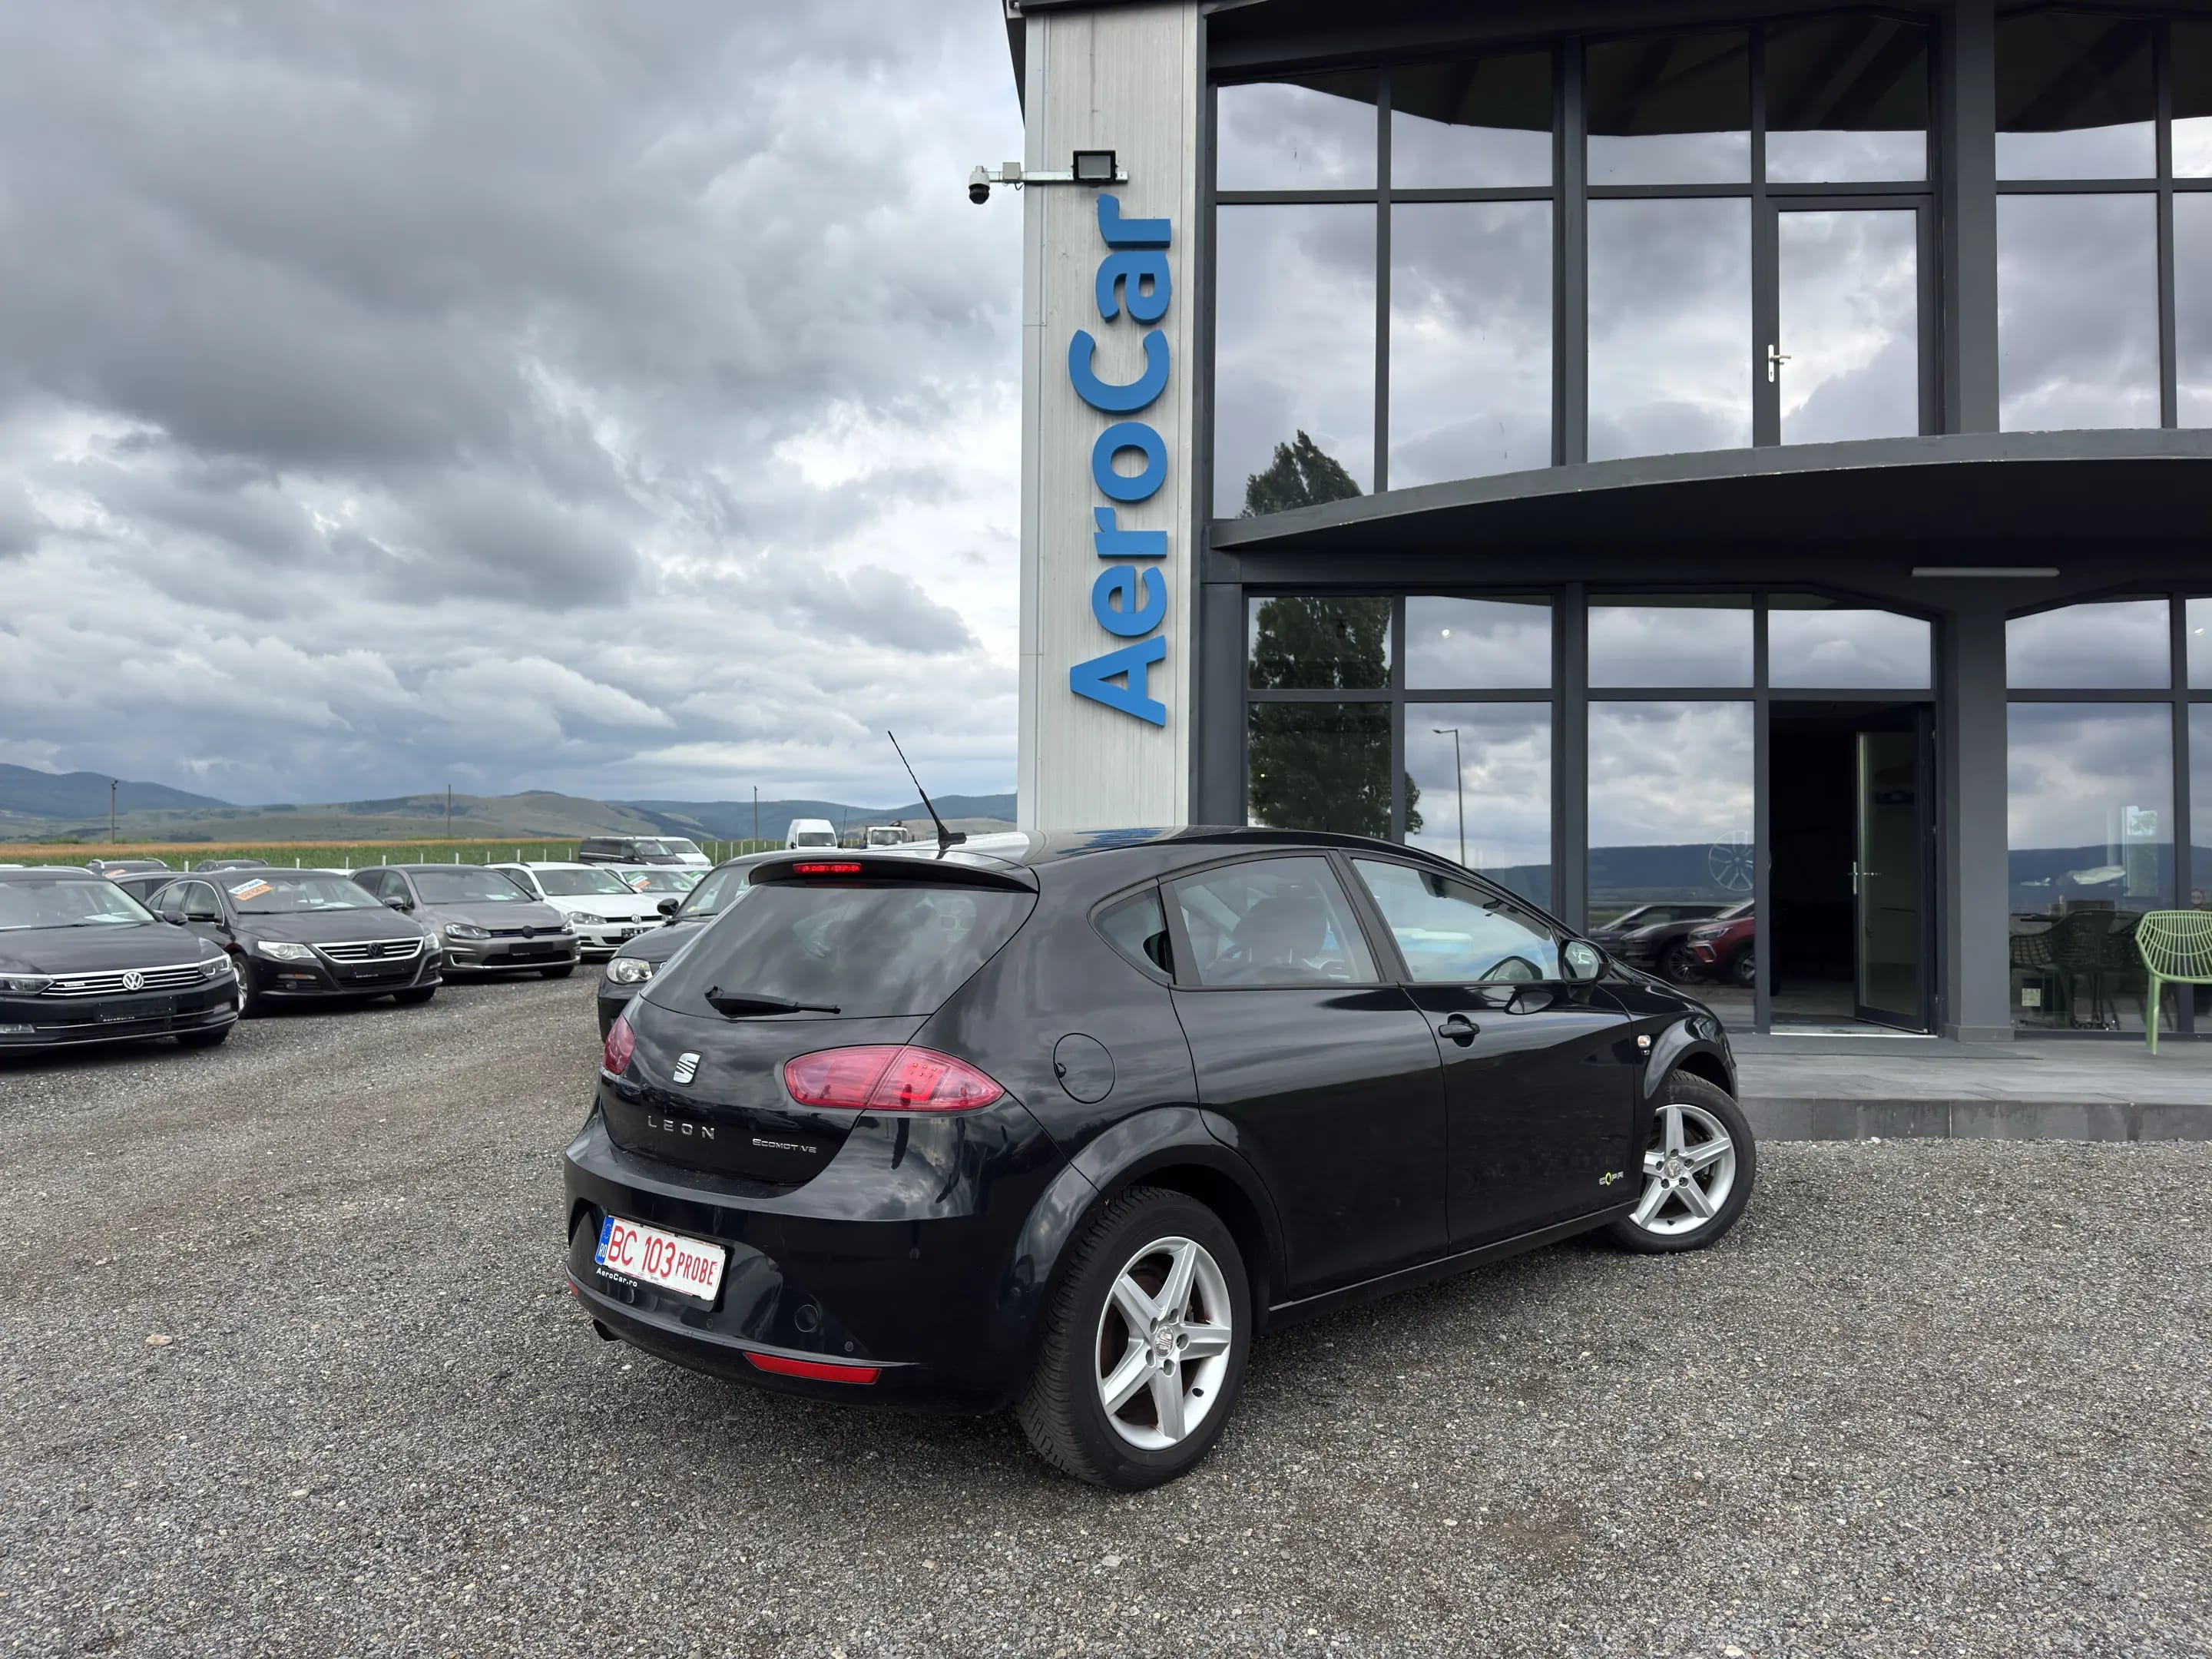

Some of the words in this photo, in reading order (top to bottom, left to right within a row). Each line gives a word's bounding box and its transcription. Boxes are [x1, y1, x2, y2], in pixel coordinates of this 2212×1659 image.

[1068, 194, 1171, 727] AeroCar
[647, 1115, 715, 1141] LEON
[599, 1243, 608, 1258] RO
[608, 1225, 637, 1266] BC
[641, 1235, 676, 1278] 103
[675, 1250, 718, 1286] PROBE
[596, 1267, 638, 1288] AeroCar.ro
